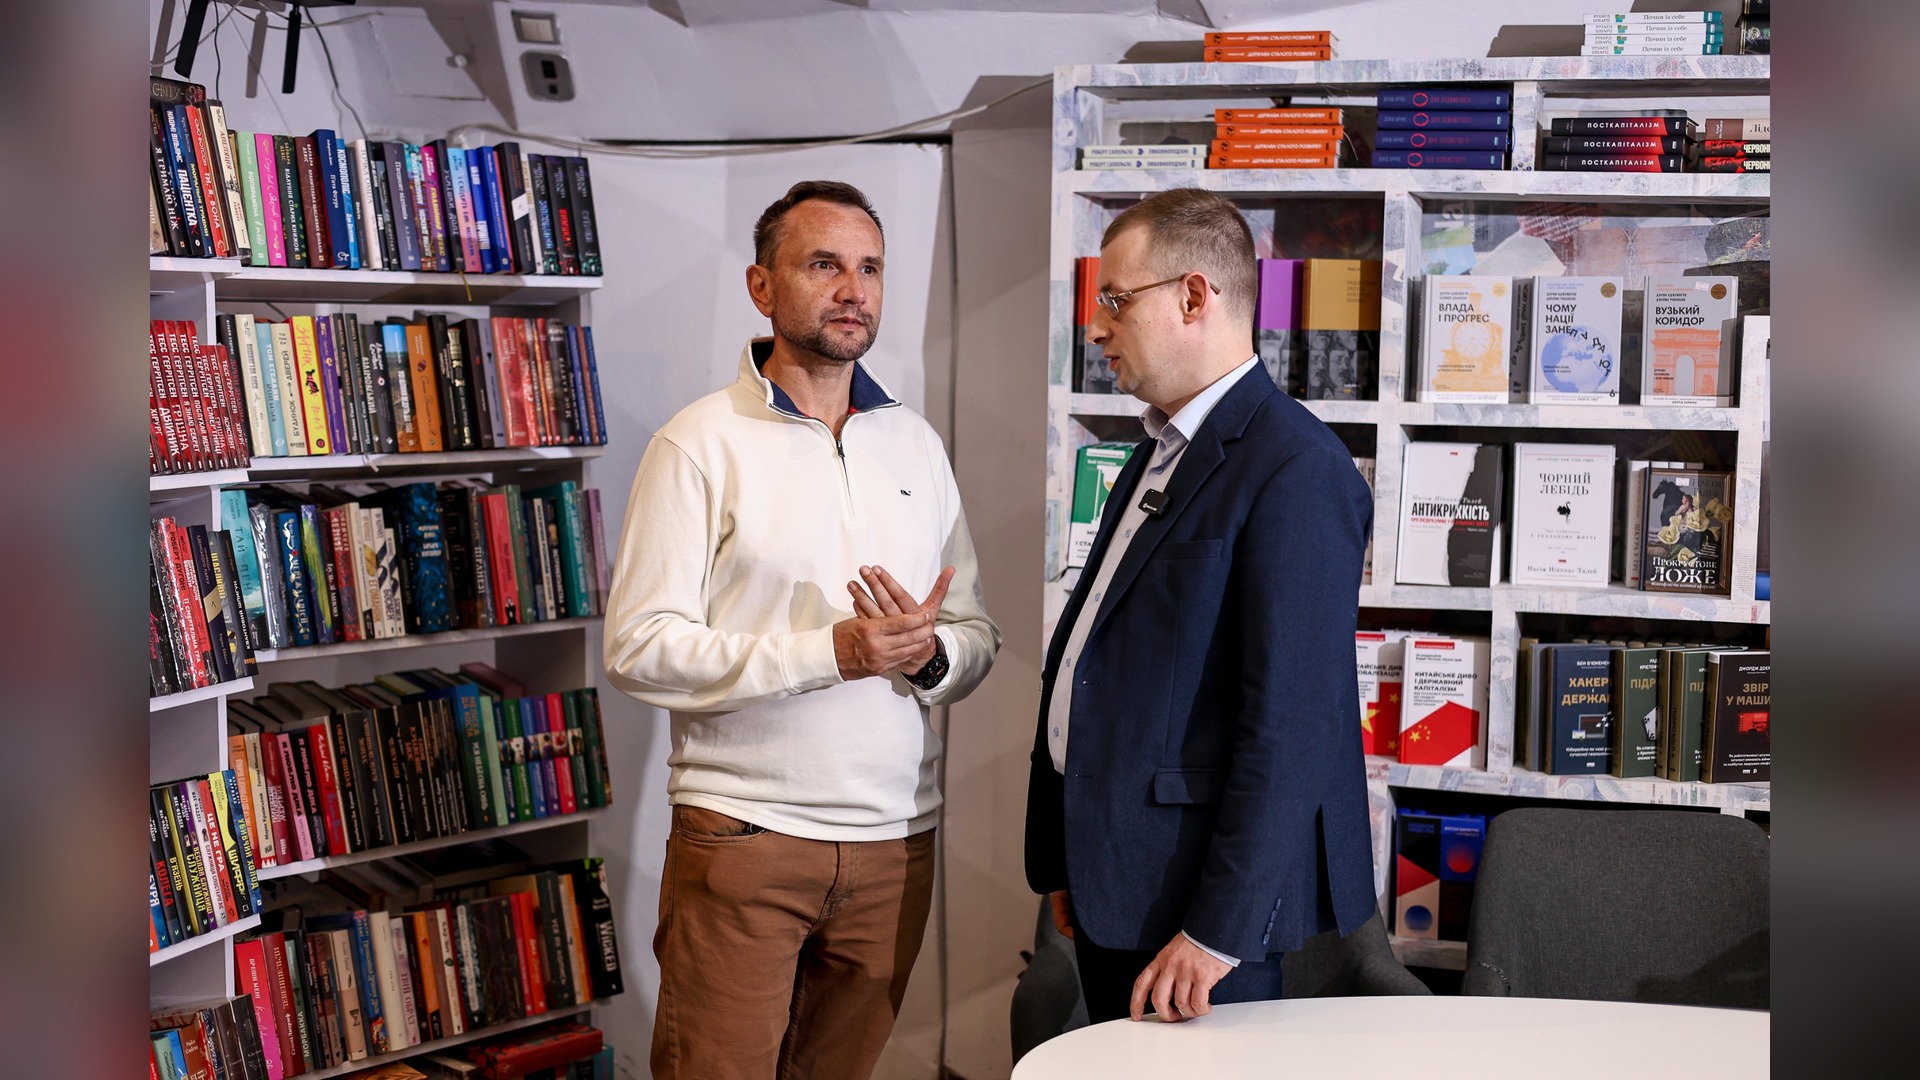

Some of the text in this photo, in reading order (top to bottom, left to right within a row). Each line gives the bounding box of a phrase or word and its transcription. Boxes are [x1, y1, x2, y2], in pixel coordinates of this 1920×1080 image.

[166, 111, 178, 132] НАОМІ
[193, 118, 208, 166] СЬЮ ВОТСОН
[337, 149, 350, 194] КОСМОПОЛІС
[156, 157, 173, 205] ТРИМАЮ
[165, 208, 180, 230] НІЖ
[176, 169, 199, 226] ПАЦІЄНТКА
[209, 200, 221, 229] ВОНА
[288, 200, 297, 223] СТАРИХ
[291, 224, 300, 252] КНИЖОК
[1439, 304, 1474, 313] ВЛАДА
[1546, 304, 1577, 312] ЧОМУ
[1546, 313, 1574, 324] НАЦІЇ
[1656, 305, 1700, 314] ВУЗЬКИЙ
[1656, 317, 1705, 326] КОРИДОР
[157, 332, 167, 353] ТЕСС
[191, 335, 201, 355] ТЕСС
[266, 344, 274, 362] ТОМ
[168, 333, 178, 353] ТЕСС
[184, 406, 195, 427] ЗНАЮ
[190, 427, 200, 453] СЕКРЕТ
[179, 333, 189, 353] ТЕСС
[203, 436, 211, 453] МЕНЕ
[209, 354, 219, 371] ТЕСС
[223, 416, 235, 450] АСИСТЕНТ
[222, 360, 231, 377] ТЕСС
[235, 422, 245, 447] ХІРУРГ
[282, 350, 300, 437] БУДИНОК ДВЕРЕЙ
[150, 408, 163, 436] ХІРУРГ
[159, 406, 180, 457] ДВІЙНИК
[1539, 473, 1591, 484] ЧОРНИЙ
[1540, 485, 1589, 496] ЛЕБІДЬ
[1412, 503, 1490, 520] АНТИКРИХКІСТЬ
[169, 531, 180, 561] РОБЕРТ
[474, 546, 485, 594] ПІРАНЕЗІ
[1650, 566, 1716, 584] ЛОЖЕ
[162, 575, 173, 610] СТЕЖУ
[383, 589, 393, 620] БОСМЕН
[171, 612, 177, 624] ЗА
[185, 606, 197, 649] СМЕРТЕЛЬНА
[233, 581, 250, 650] КВАНТОВИЙ ШПИГУН
[173, 628, 185, 660] ТОБОЮ
[1569, 678, 1611, 688] ХАКЕР
[1743, 683, 1768, 693] ЗВІР
[1726, 696, 1734, 706] У
[283, 751, 297, 791] ЛЮБЛЮ
[292, 792, 302, 817] ДІКА
[299, 747, 311, 787] ЛЮБЛЮ
[306, 789, 317, 814] ДІКА
[207, 813, 225, 873] ЦЕ НЕ ГРА
[237, 818, 256, 858] УБИВЧИЙ
[247, 861, 260, 890] ХОЛОД
[169, 857, 183, 892] В'ЯЗЕНЬ
[205, 844, 217, 875] СЛУЖНИЦЯ
[155, 860, 174, 907] КОЛЕГА
[186, 853, 206, 912] СЛУЖНИЦЯ
[192, 847, 213, 914] ВЕСІЛЛЯ СЛУЖНИЦІ
[298, 1011, 310, 1057] МОРБАККА
